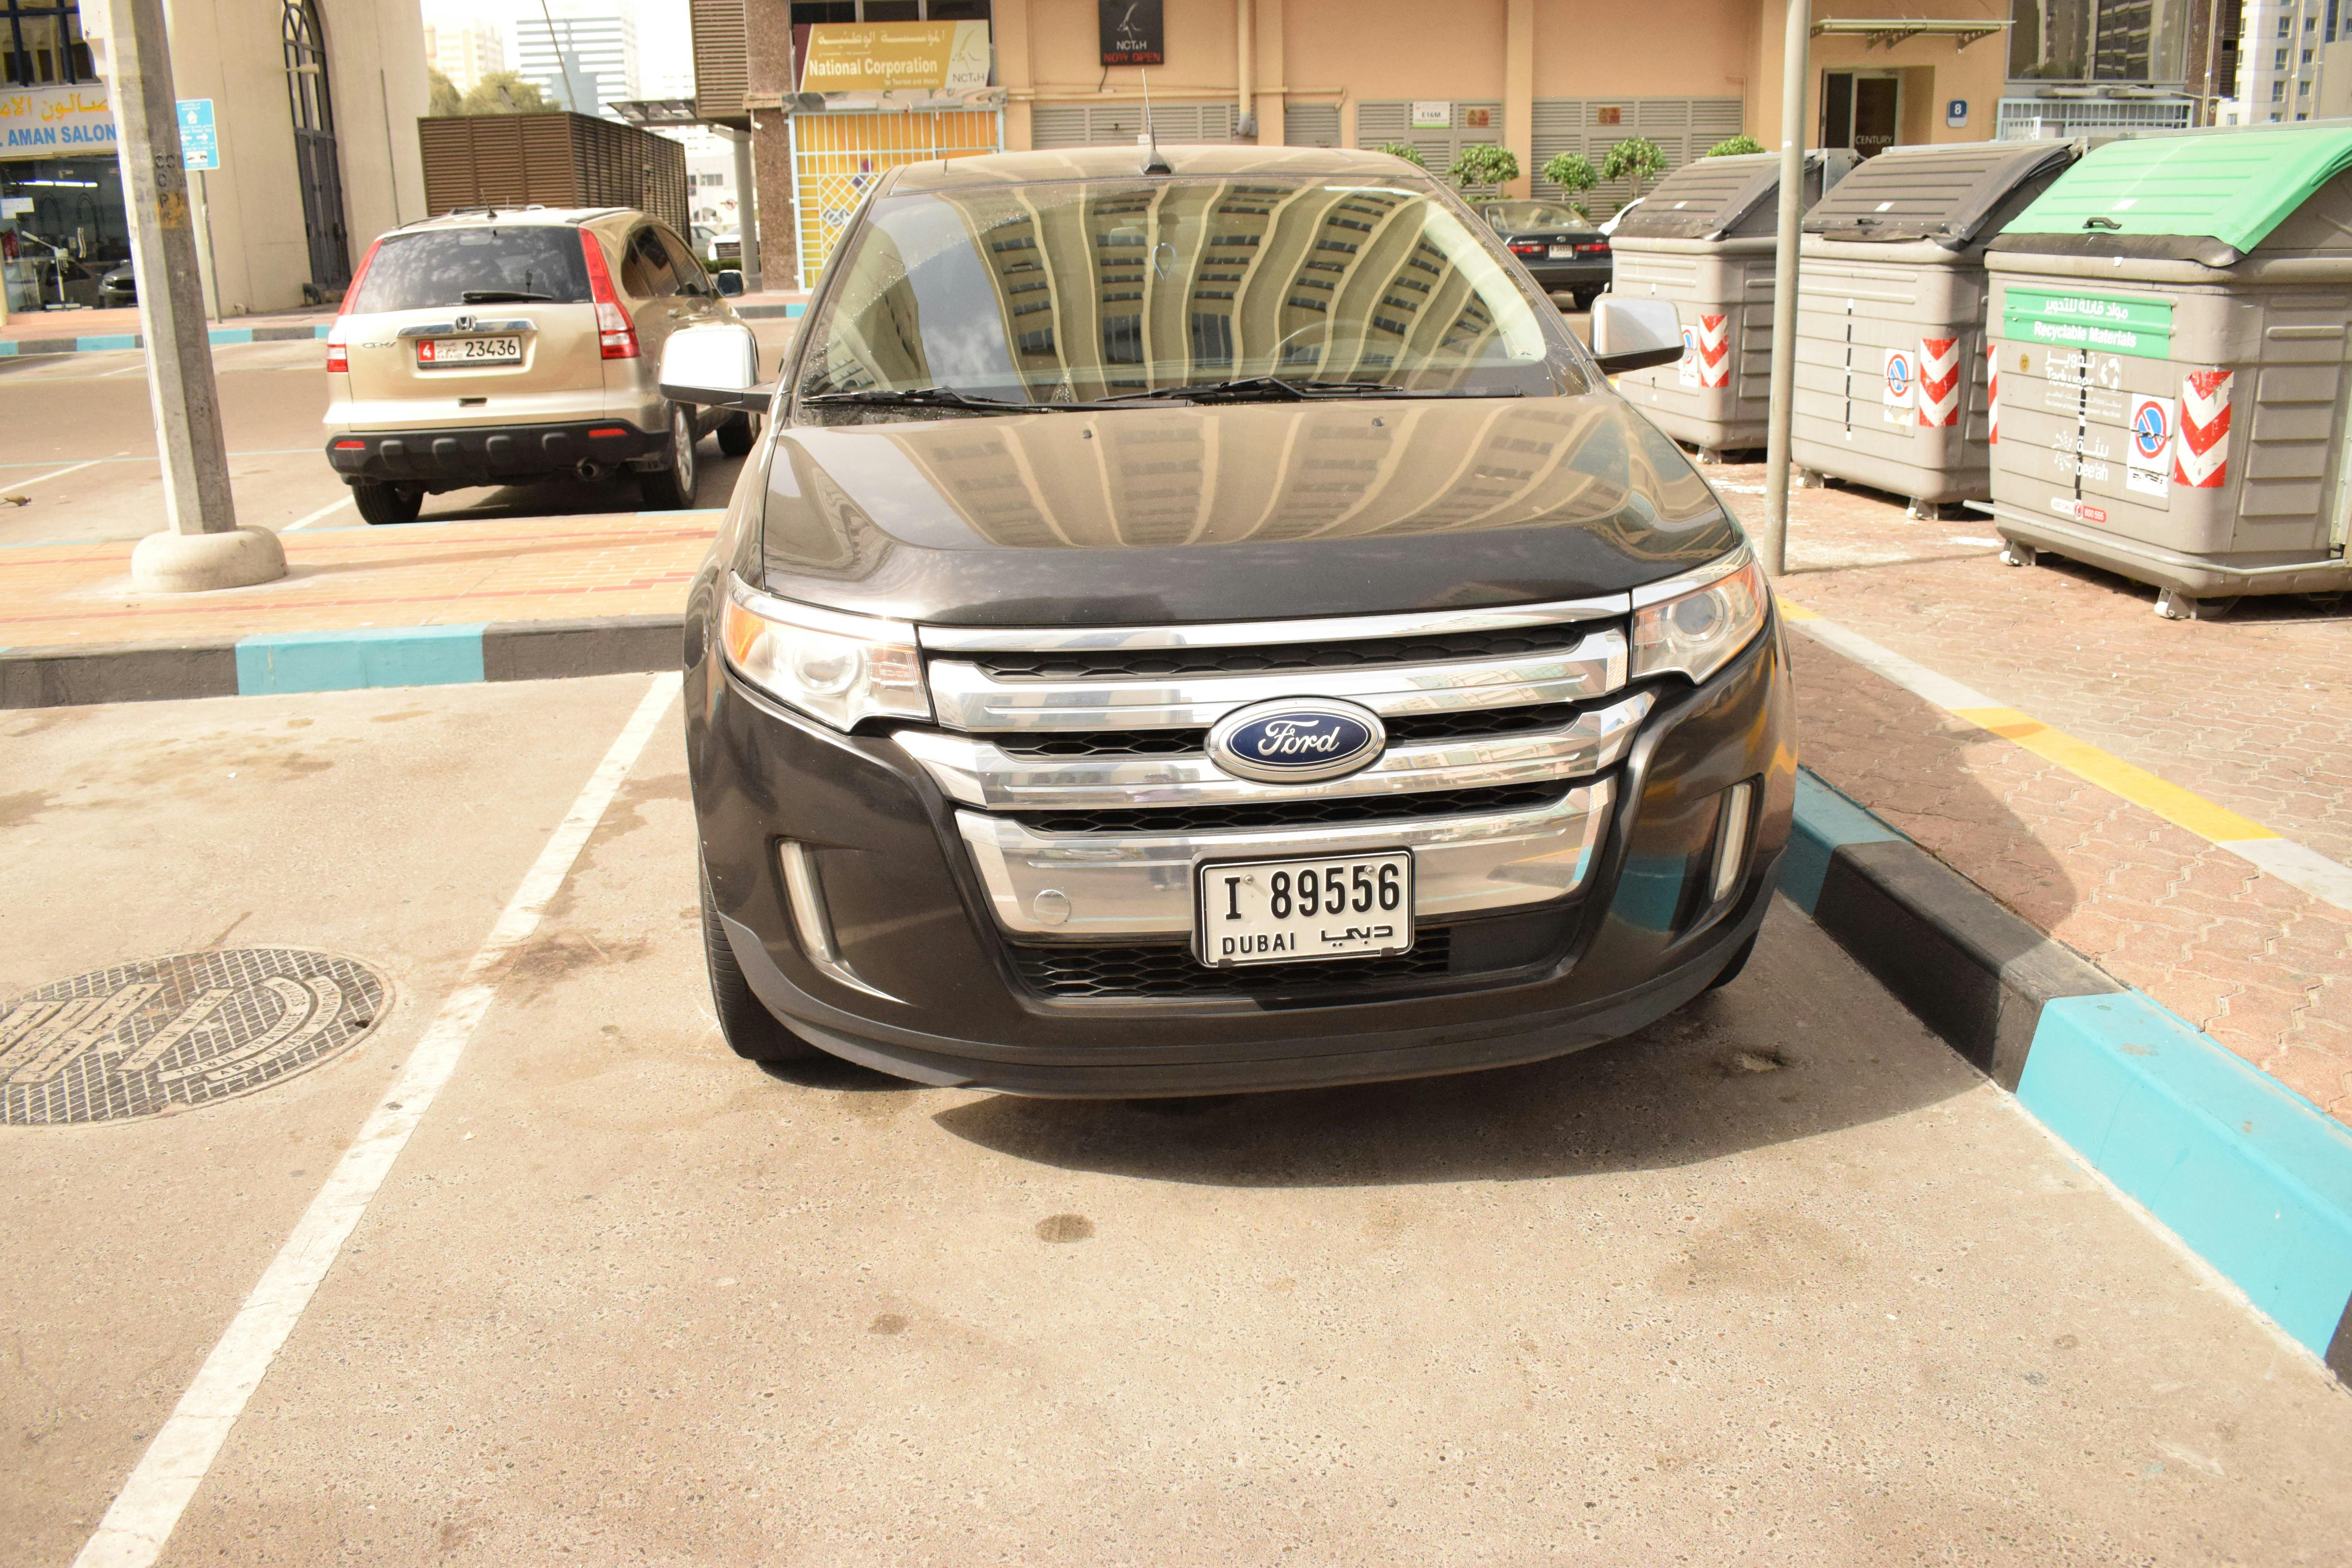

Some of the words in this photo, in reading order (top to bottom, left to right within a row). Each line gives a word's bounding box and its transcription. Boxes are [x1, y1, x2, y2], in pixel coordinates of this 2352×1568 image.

[818, 31, 875, 49] الوطنية
[809, 58, 862, 76] National
[864, 56, 937, 78] Corporation
[1103, 53, 1128, 63] NOW
[1132, 52, 1161, 62] OPEN
[1954, 103, 1962, 115] 8
[8, 127, 56, 147] AMAN
[61, 124, 117, 143] SALON
[1855, 135, 1892, 145] CENTURY
[2043, 297, 2077, 314] للتدوير
[2078, 298, 2104, 319] قابلة
[2105, 302, 2128, 320] مواد
[2034, 321, 2087, 341] Recyclable
[2089, 327, 2137, 348] Materials
[423, 345, 432, 358] 4
[465, 339, 516, 357] 23436
[2045, 350, 2095, 369] تدوير
[1257, 719, 1340, 756] Ford
[1223, 877, 1242, 920] I
[1270, 863, 1400, 919] 89556
[1222, 931, 1295, 955] DUBAI
[1320, 925, 1393, 947] دبي
[176, 1056, 234, 1076] TOWN
[246, 1011, 303, 1051] DRAINAGE
[220, 1060, 259, 1076] ABU
[266, 1031, 314, 1056] DHABI
